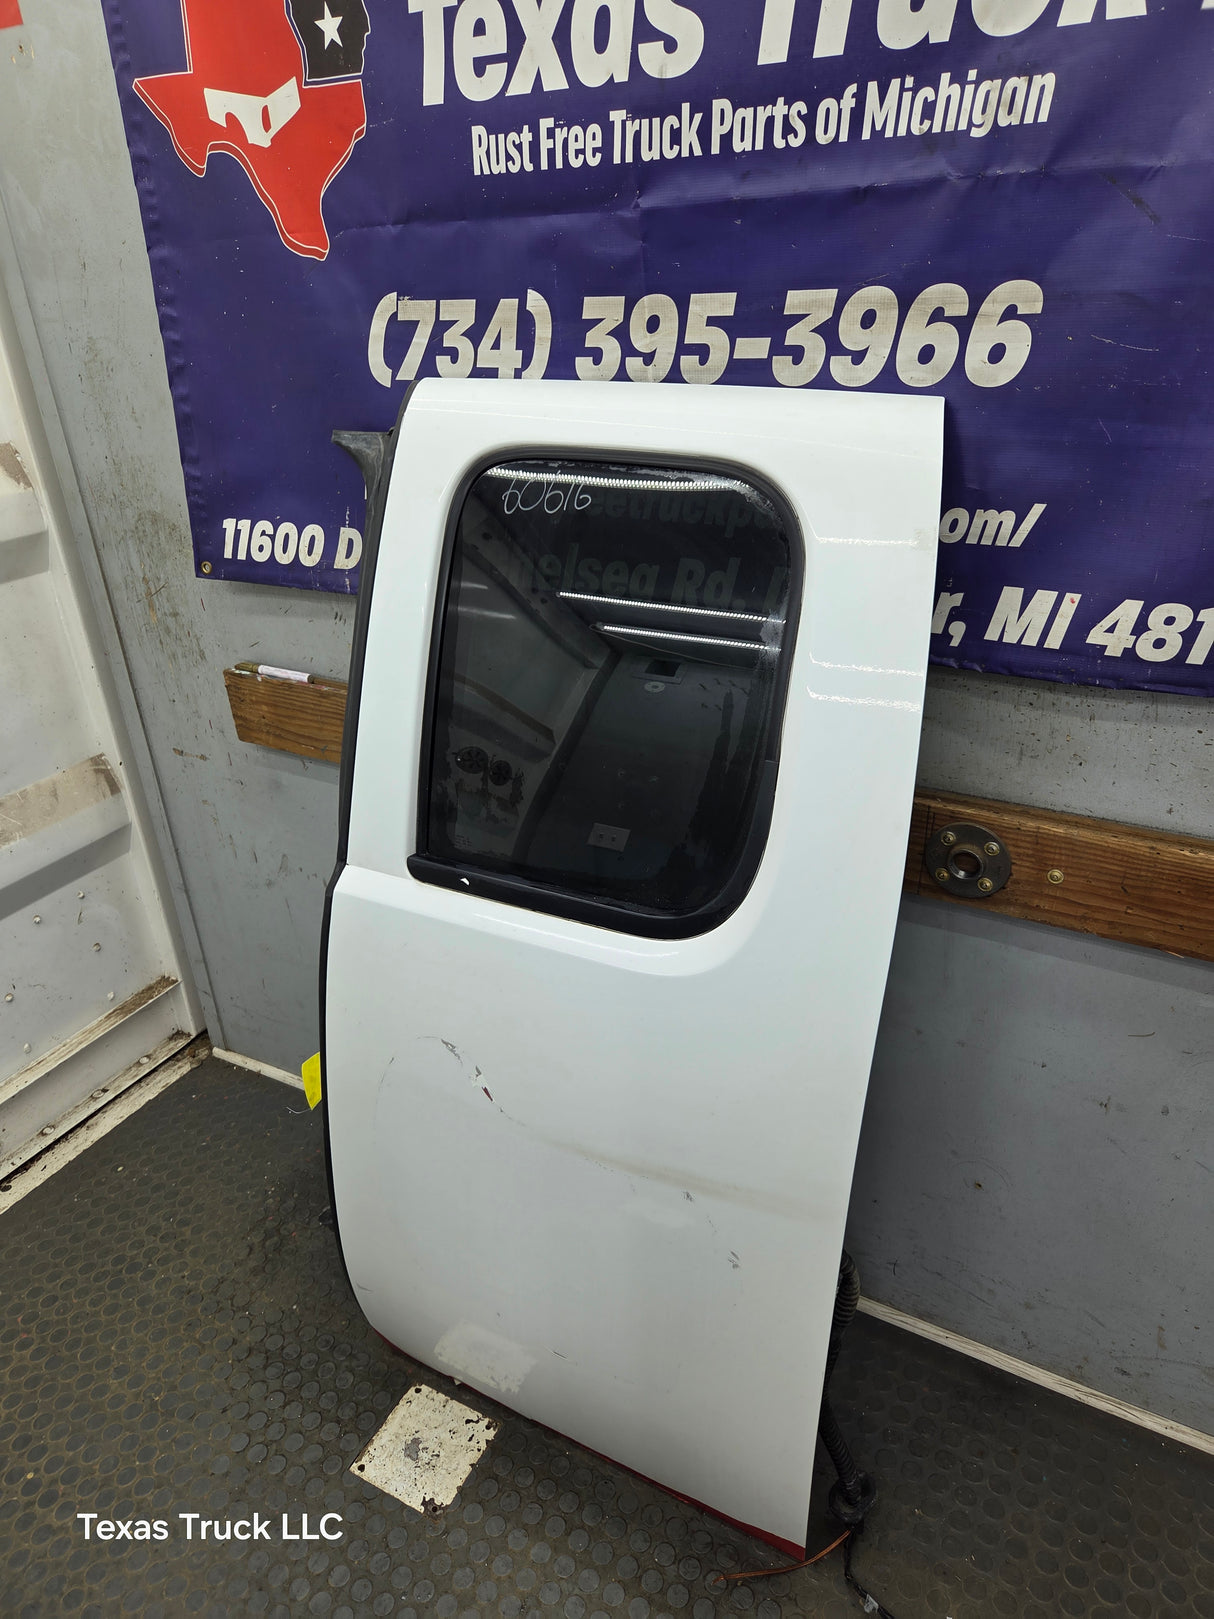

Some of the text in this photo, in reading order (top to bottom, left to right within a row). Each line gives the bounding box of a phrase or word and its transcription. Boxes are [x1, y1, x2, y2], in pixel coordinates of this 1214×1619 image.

[408, 0, 705, 106] Texas
[471, 69, 1056, 176] Rust Free Truck Parts of Michigan
[368, 279, 1045, 388] (734) 395-3966
[222, 518, 325, 567] 11600
[333, 527, 363, 570] D
[670, 556, 746, 611] Rd.
[984, 586, 1082, 650] MI
[1085, 599, 1214, 666] 481
